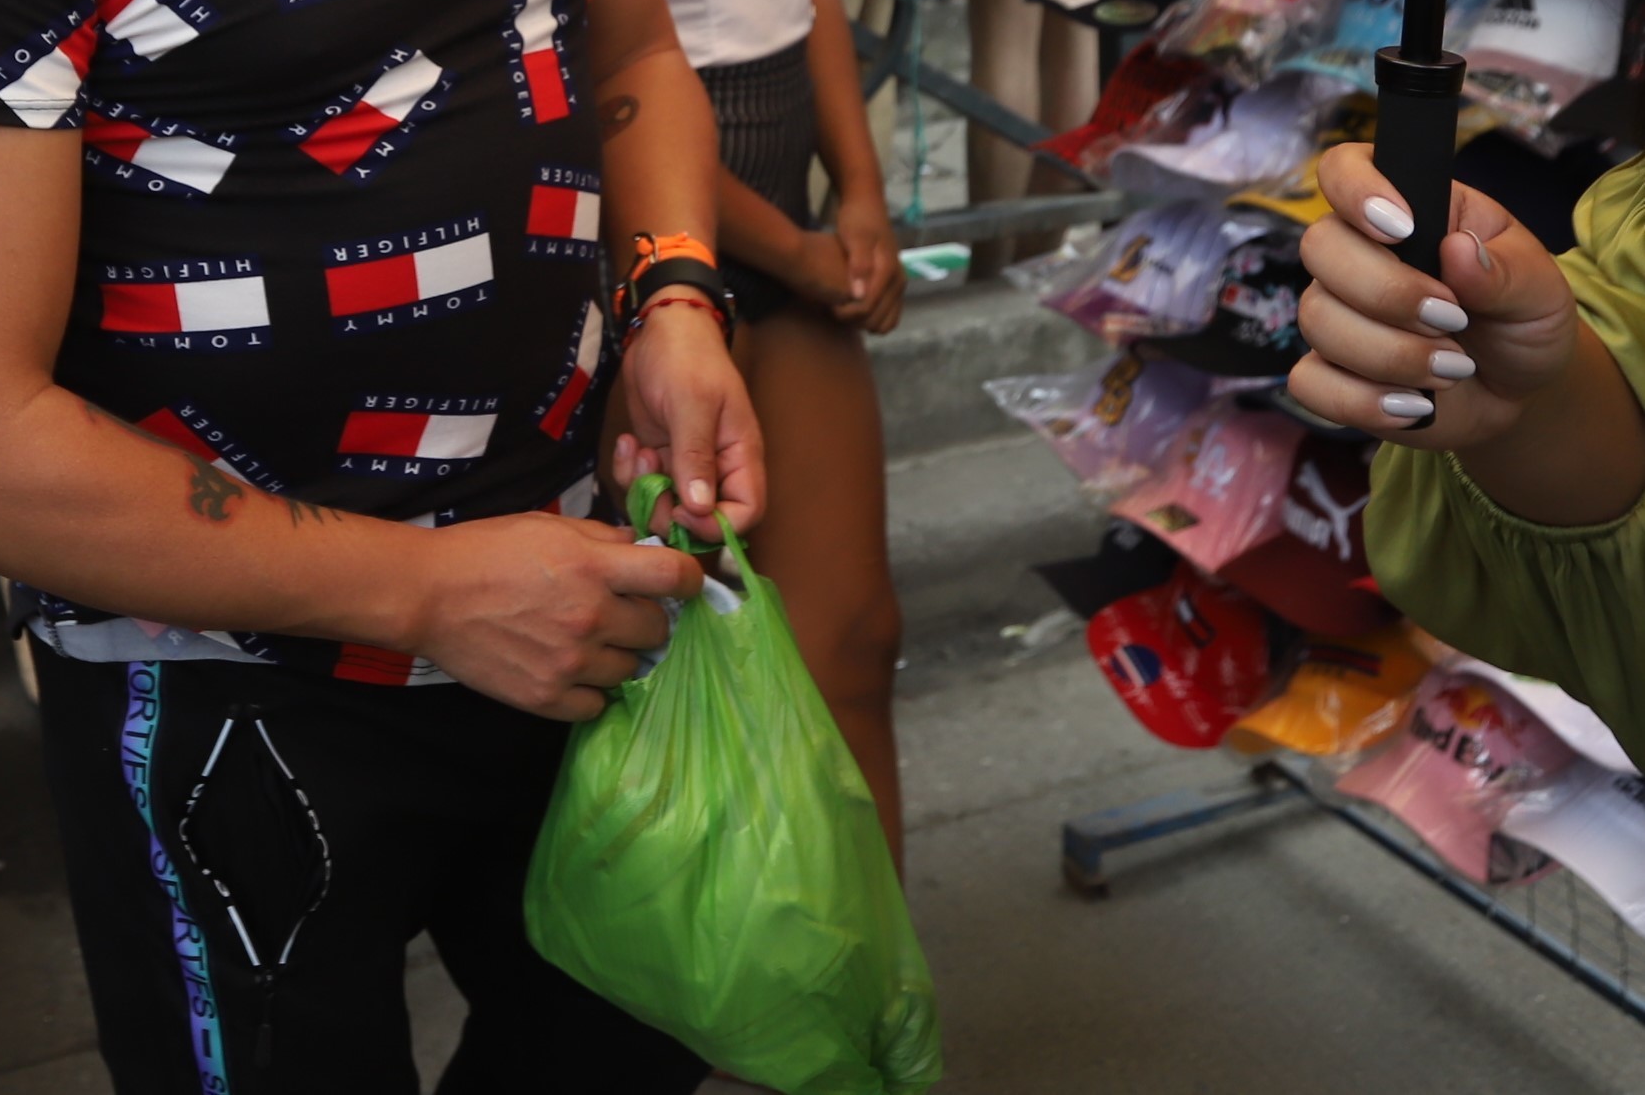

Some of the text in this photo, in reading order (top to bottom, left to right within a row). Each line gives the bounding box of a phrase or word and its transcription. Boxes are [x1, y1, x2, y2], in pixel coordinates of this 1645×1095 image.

[502, 4, 533, 118] HLFIGER
[333, 217, 481, 262] HILFIGER
[106, 258, 252, 280] HILFIGER
[344, 288, 488, 333] TOMMY
[365, 395, 498, 410] HILFIGER
[179, 405, 285, 494] HILFIGER
